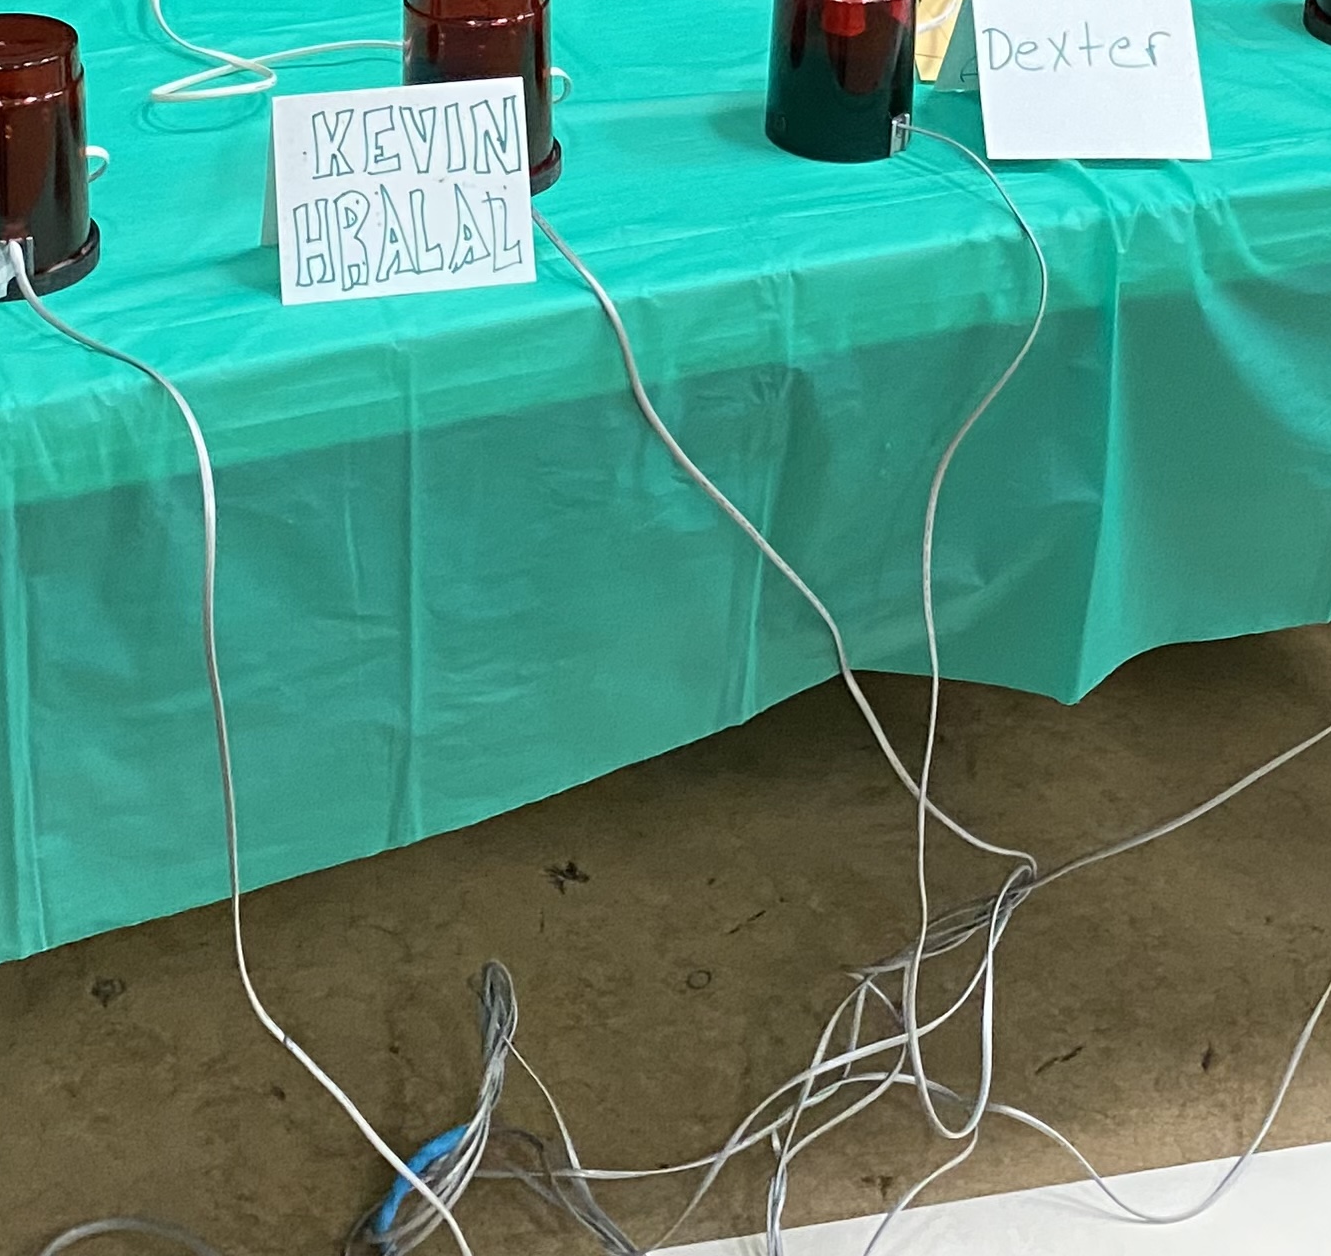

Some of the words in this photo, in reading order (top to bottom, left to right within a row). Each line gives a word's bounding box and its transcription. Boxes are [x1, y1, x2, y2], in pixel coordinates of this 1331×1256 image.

[981, 20, 1172, 73] Dexter
[311, 94, 522, 180] KEVIN
[292, 183, 523, 292] HRALAL
